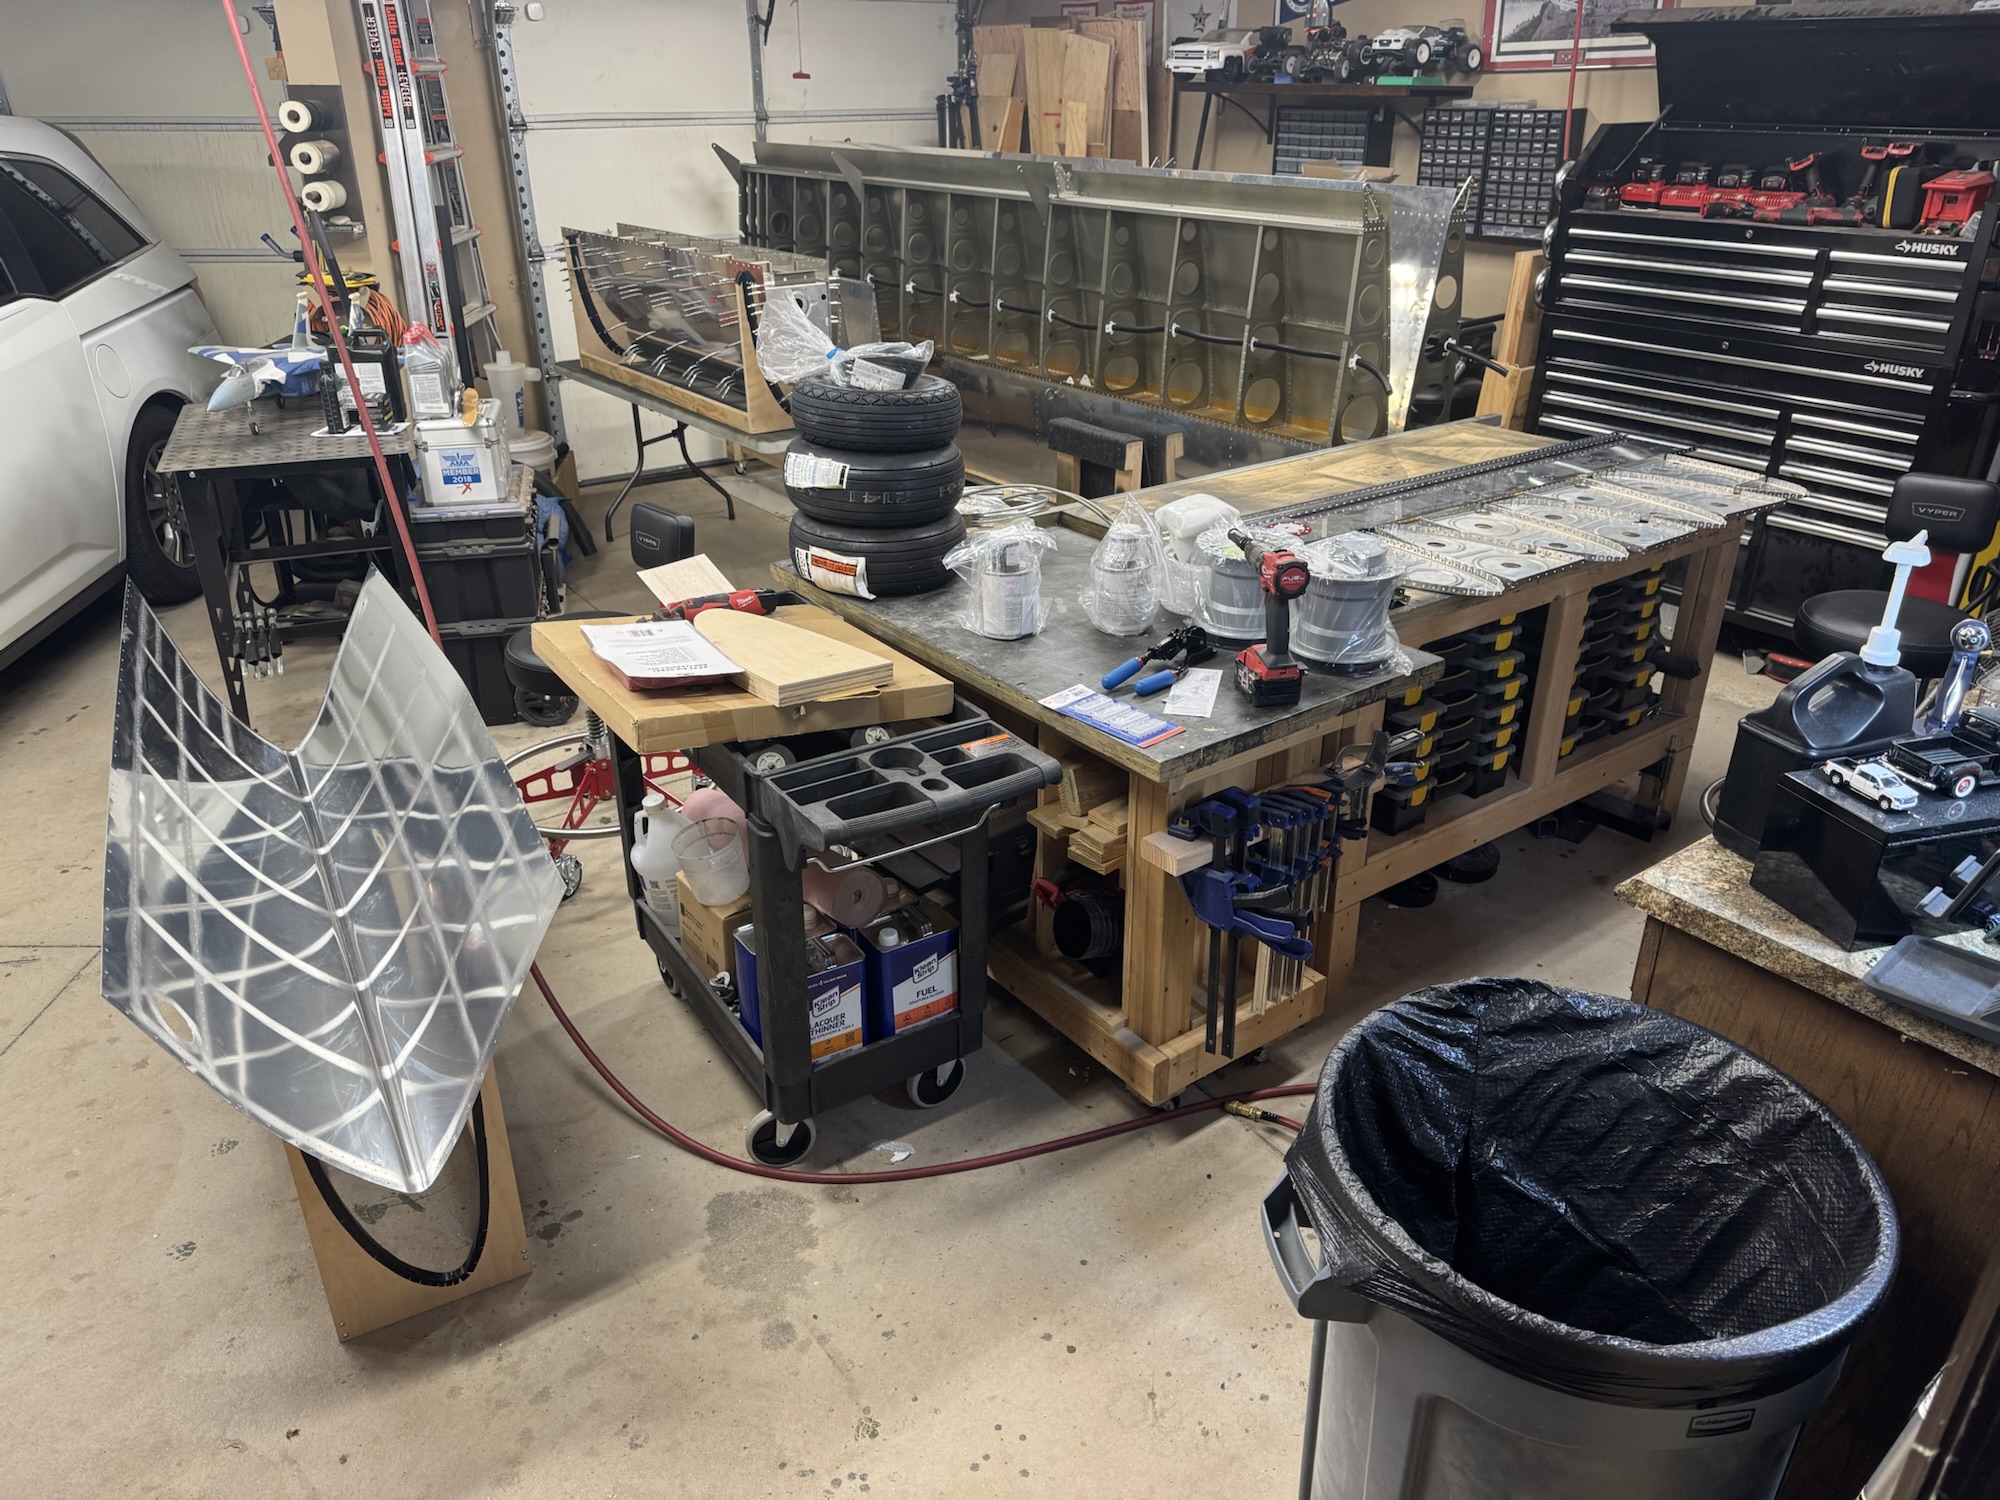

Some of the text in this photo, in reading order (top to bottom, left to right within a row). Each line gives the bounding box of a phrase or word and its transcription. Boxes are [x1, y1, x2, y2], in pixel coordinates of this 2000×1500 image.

[386, 6, 412, 107] Little Giant LEVELER
[366, 17, 393, 117] Little Giant LEVELER
[1911, 242, 1959, 256] HUSKY
[1879, 363, 1925, 378] HUSKY
[443, 467, 480, 476] MEMBER
[452, 475, 472, 483] 2018
[1918, 507, 1957, 518] VYPER
[914, 958, 937, 975] Klean
[917, 965, 935, 979] Strip
[916, 985, 937, 998] FUEL
[814, 990, 838, 1009] Klean
[817, 998, 837, 1013] Strip
[810, 1019, 845, 1036] THINNER
[1694, 1413, 1750, 1426] Rubbermaid
